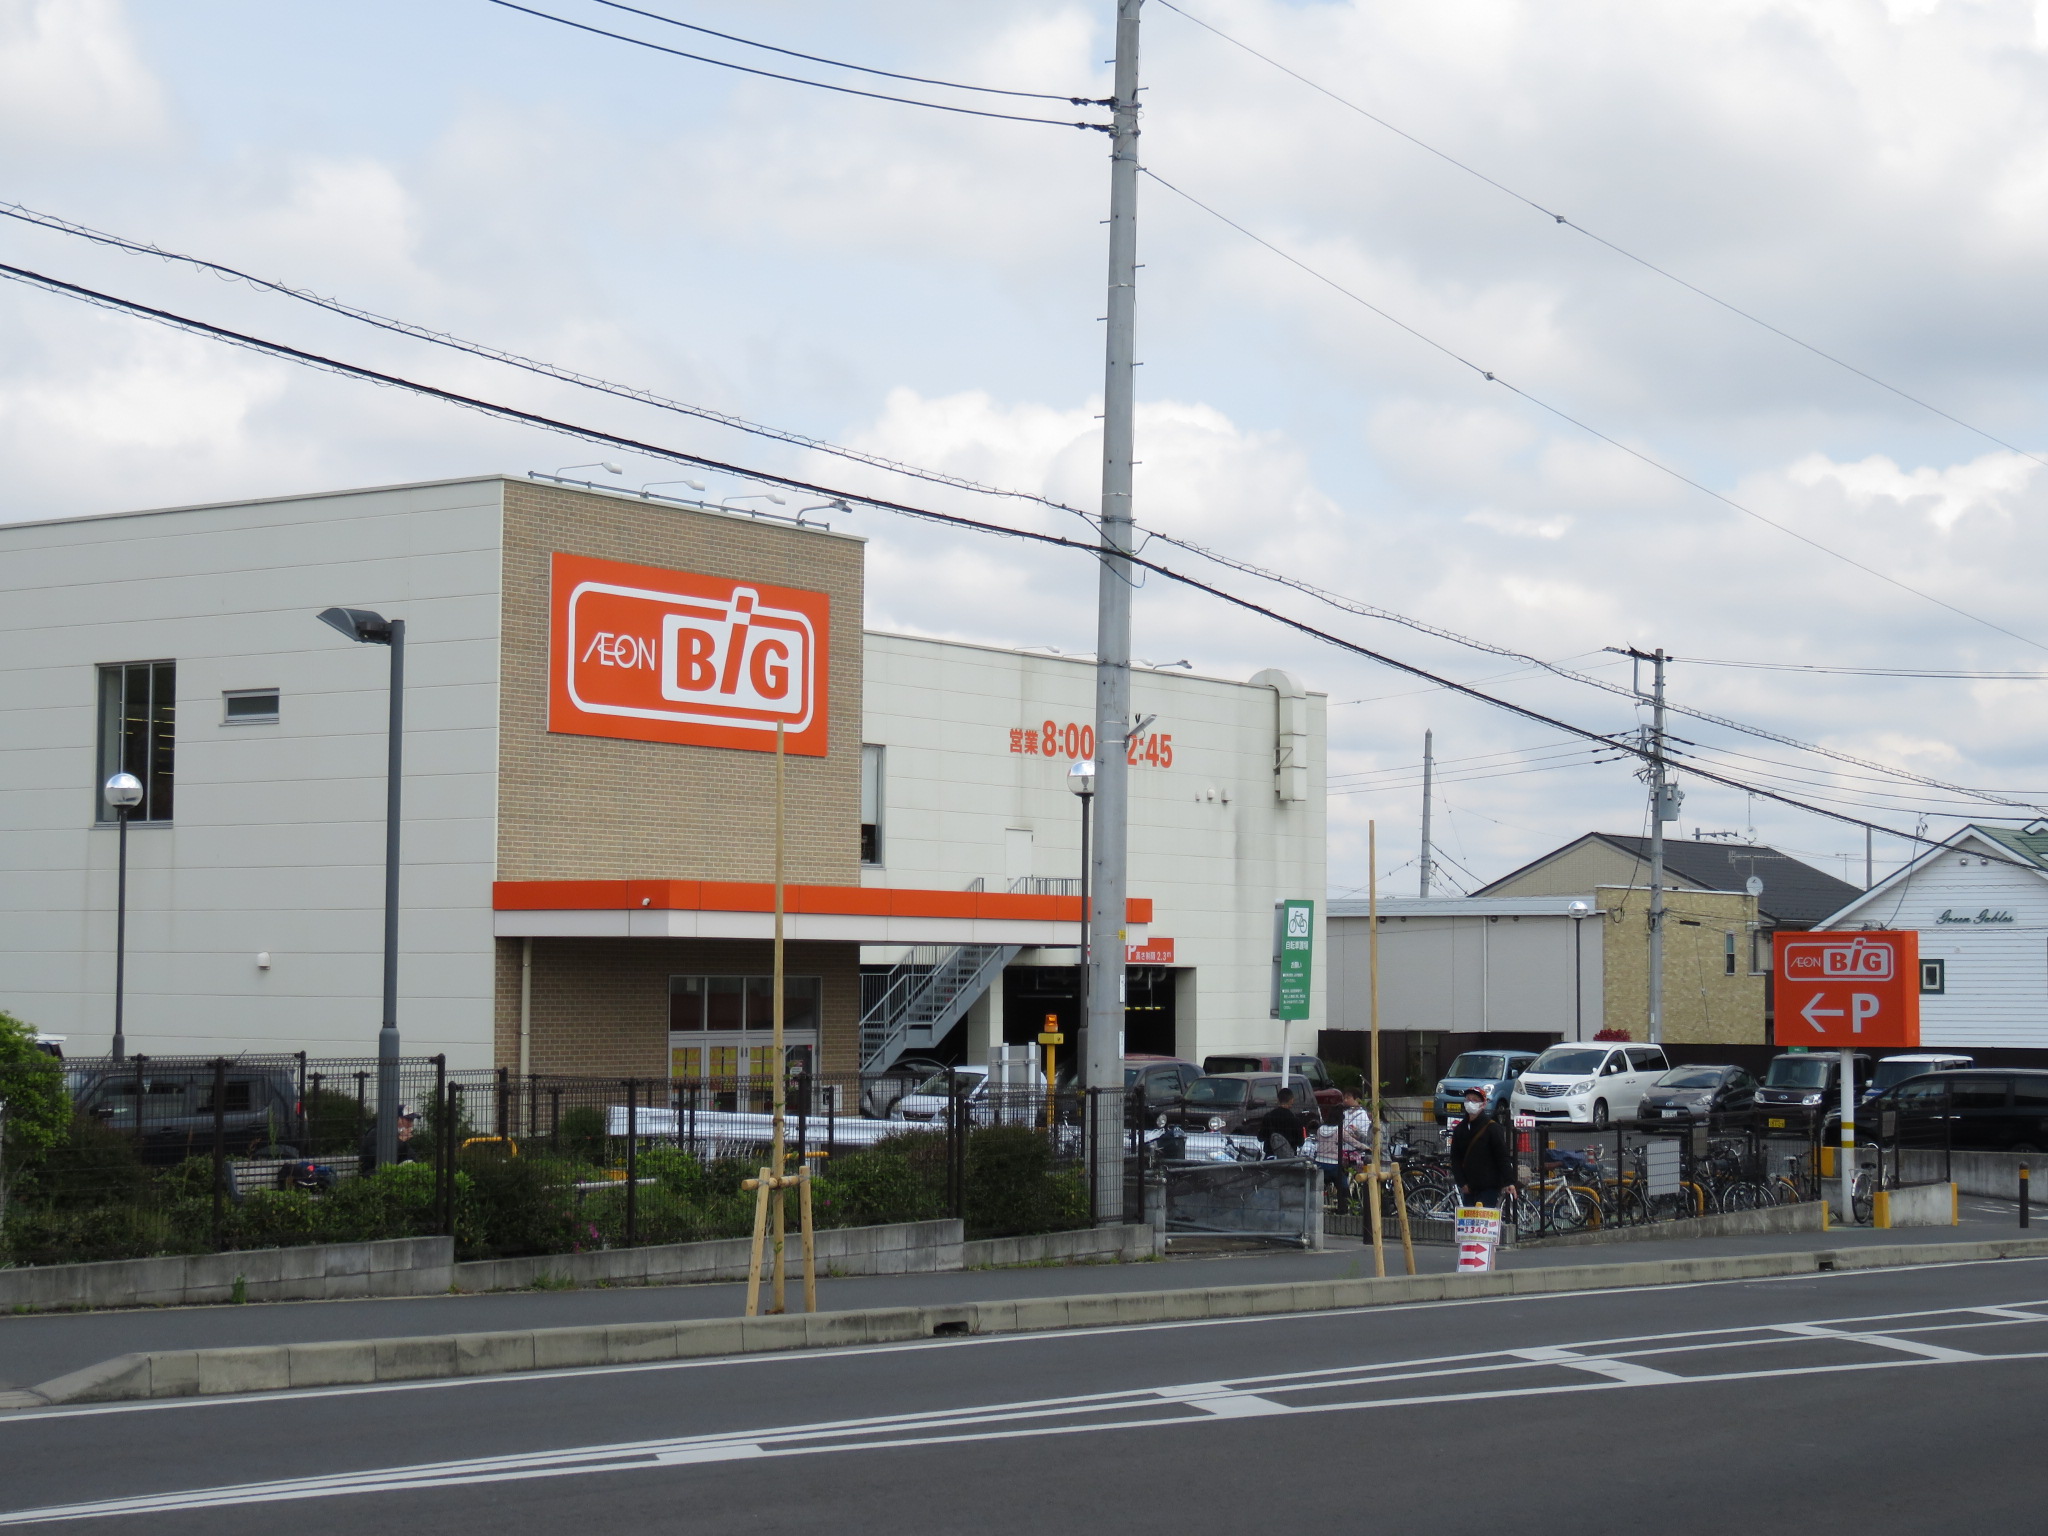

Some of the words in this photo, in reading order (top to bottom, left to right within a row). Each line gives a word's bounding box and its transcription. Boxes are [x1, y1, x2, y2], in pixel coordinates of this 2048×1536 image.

[1009, 728, 1039, 755] 営業
[1042, 720, 1095, 761] 8:00
[1936, 909, 1971, 925] Green
[1973, 908, 2014, 925] Gables
[1852, 993, 1880, 1033] P
